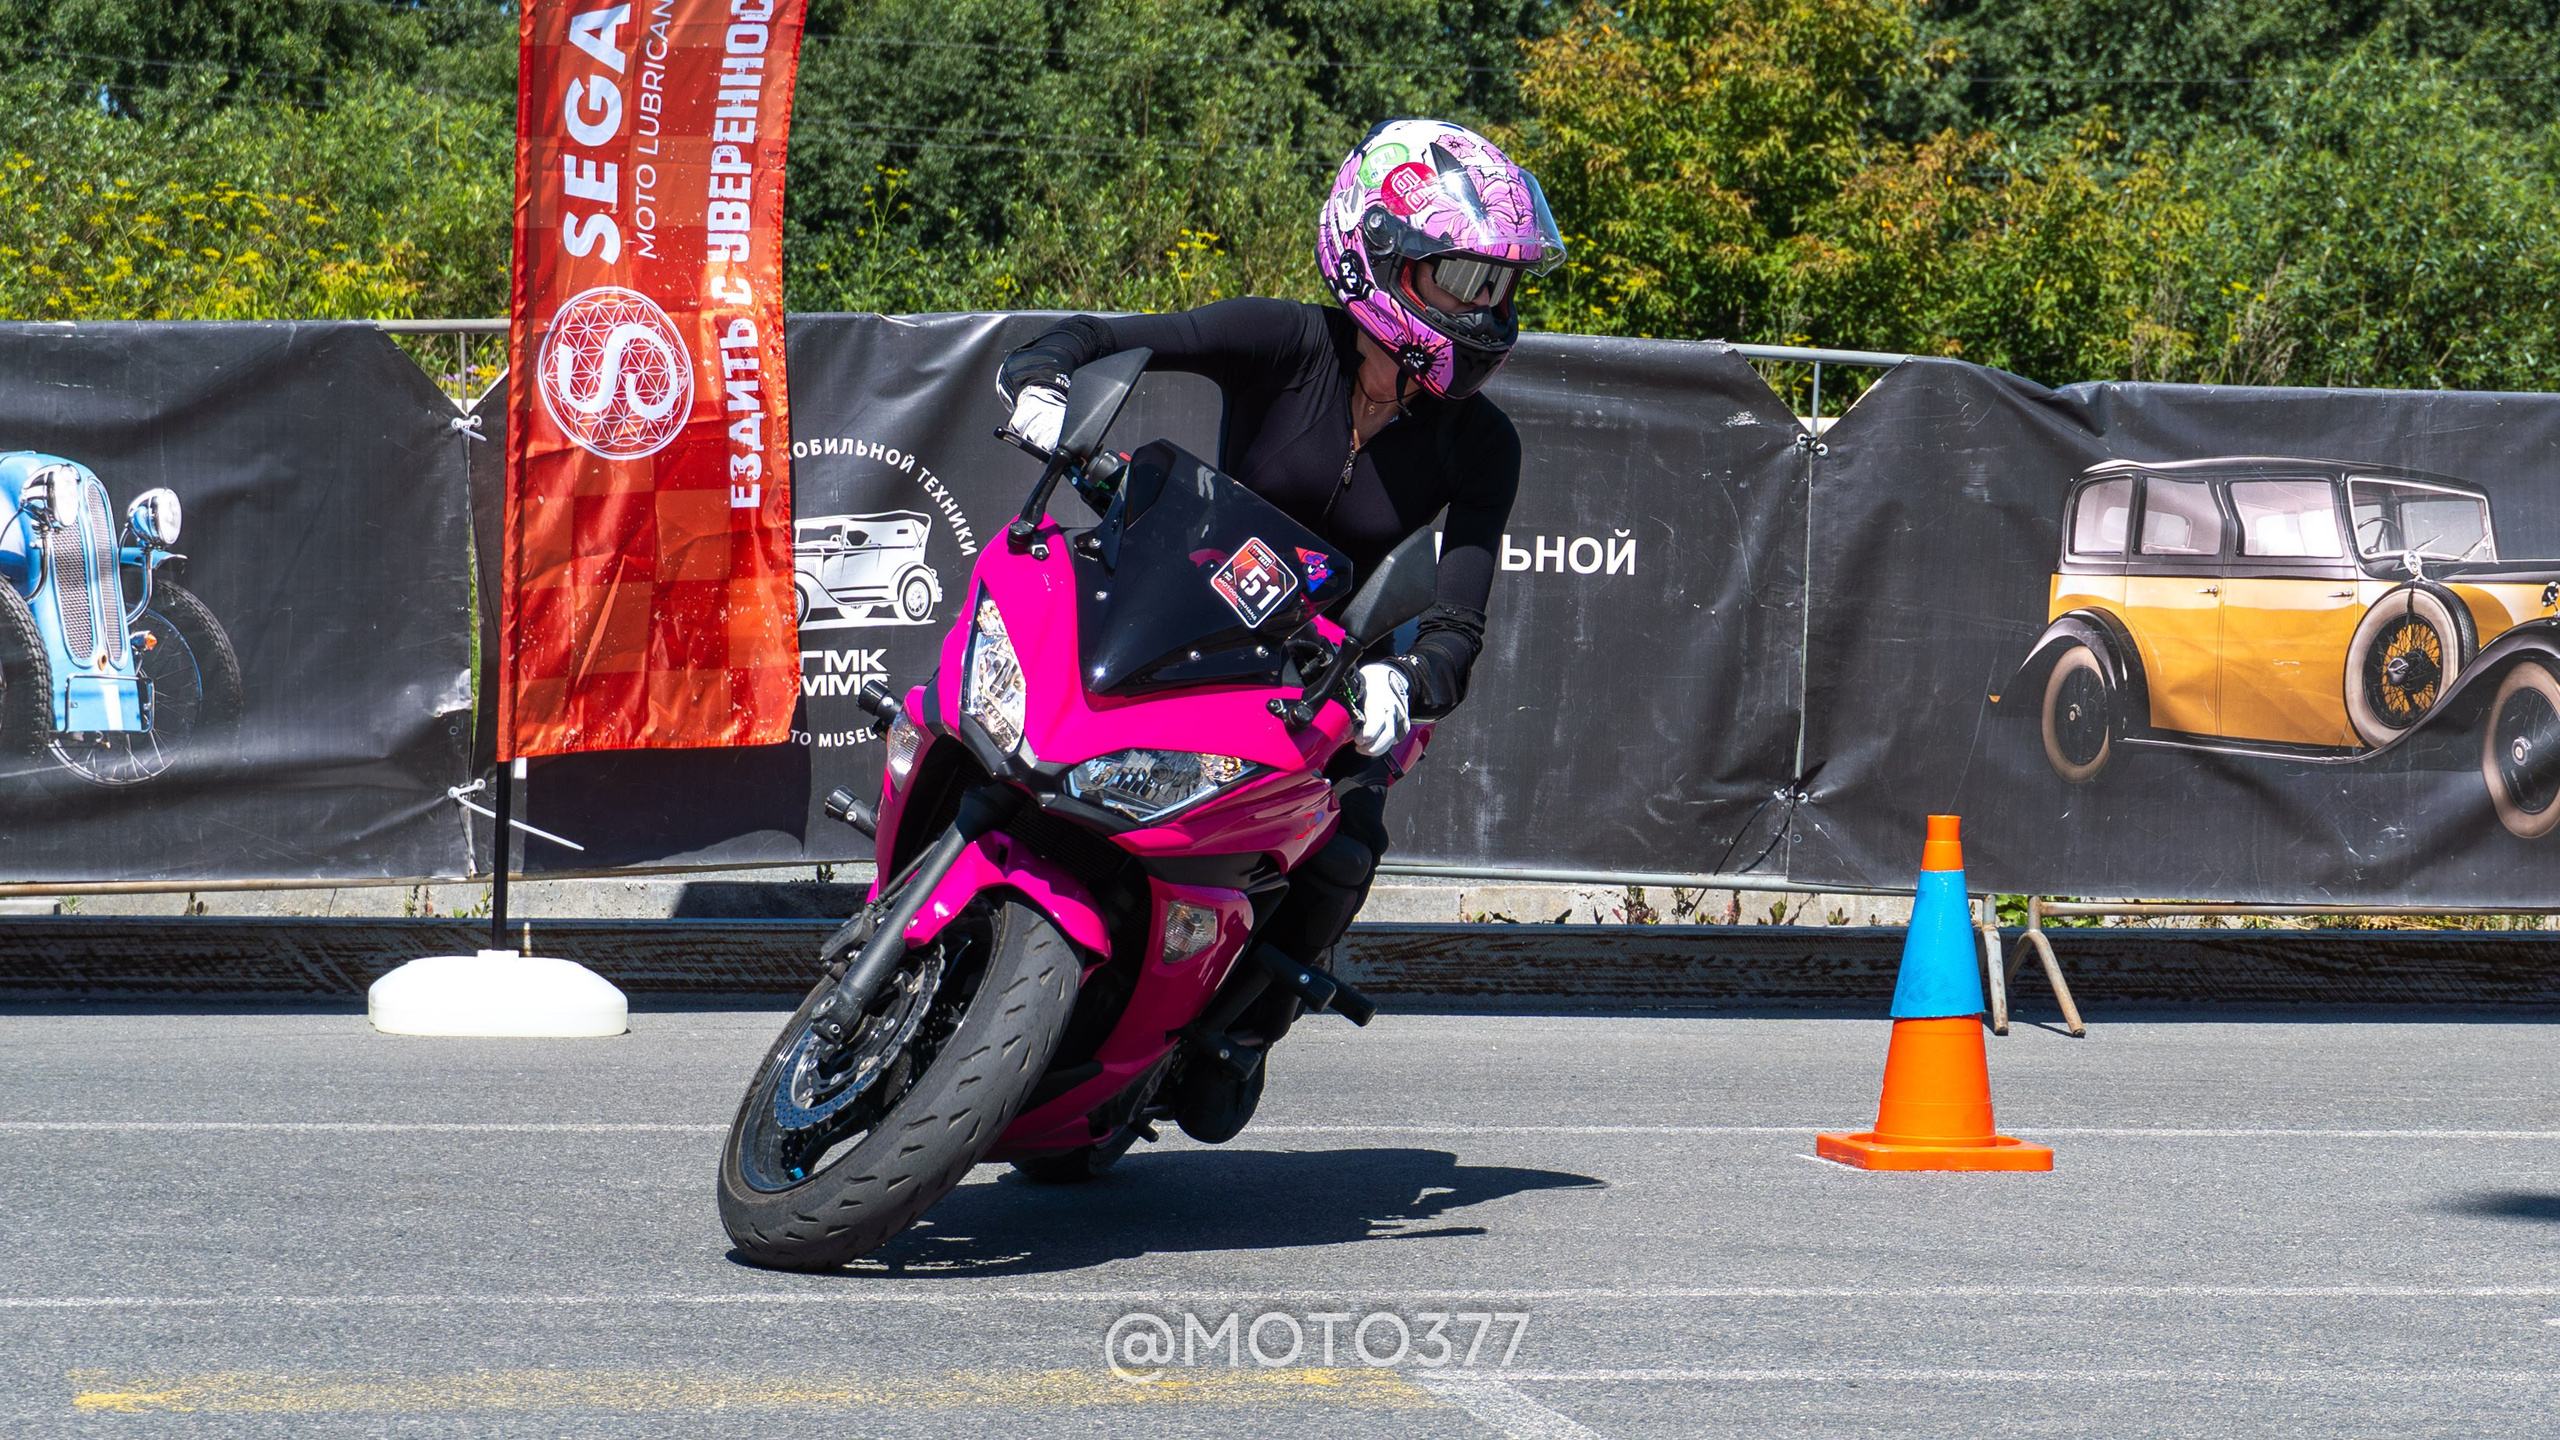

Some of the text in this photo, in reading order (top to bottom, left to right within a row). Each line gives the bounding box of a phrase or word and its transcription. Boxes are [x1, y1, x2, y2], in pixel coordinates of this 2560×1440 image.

[635, 0, 675, 260] MOTO LUBRICAN
[707, 0, 774, 263] УВЕРЕННОС
[719, 318, 765, 509] ЕЗДИТЬ
[789, 437, 978, 557] ОБИЛЬНОЙ ТЕХНИКИ
[1434, 529, 1636, 576] ЬНОЙ
[1240, 565, 1281, 610] 51
[799, 648, 888, 673] ГМК
[799, 673, 889, 697] MM
[790, 726, 878, 748] TO MUSEU
